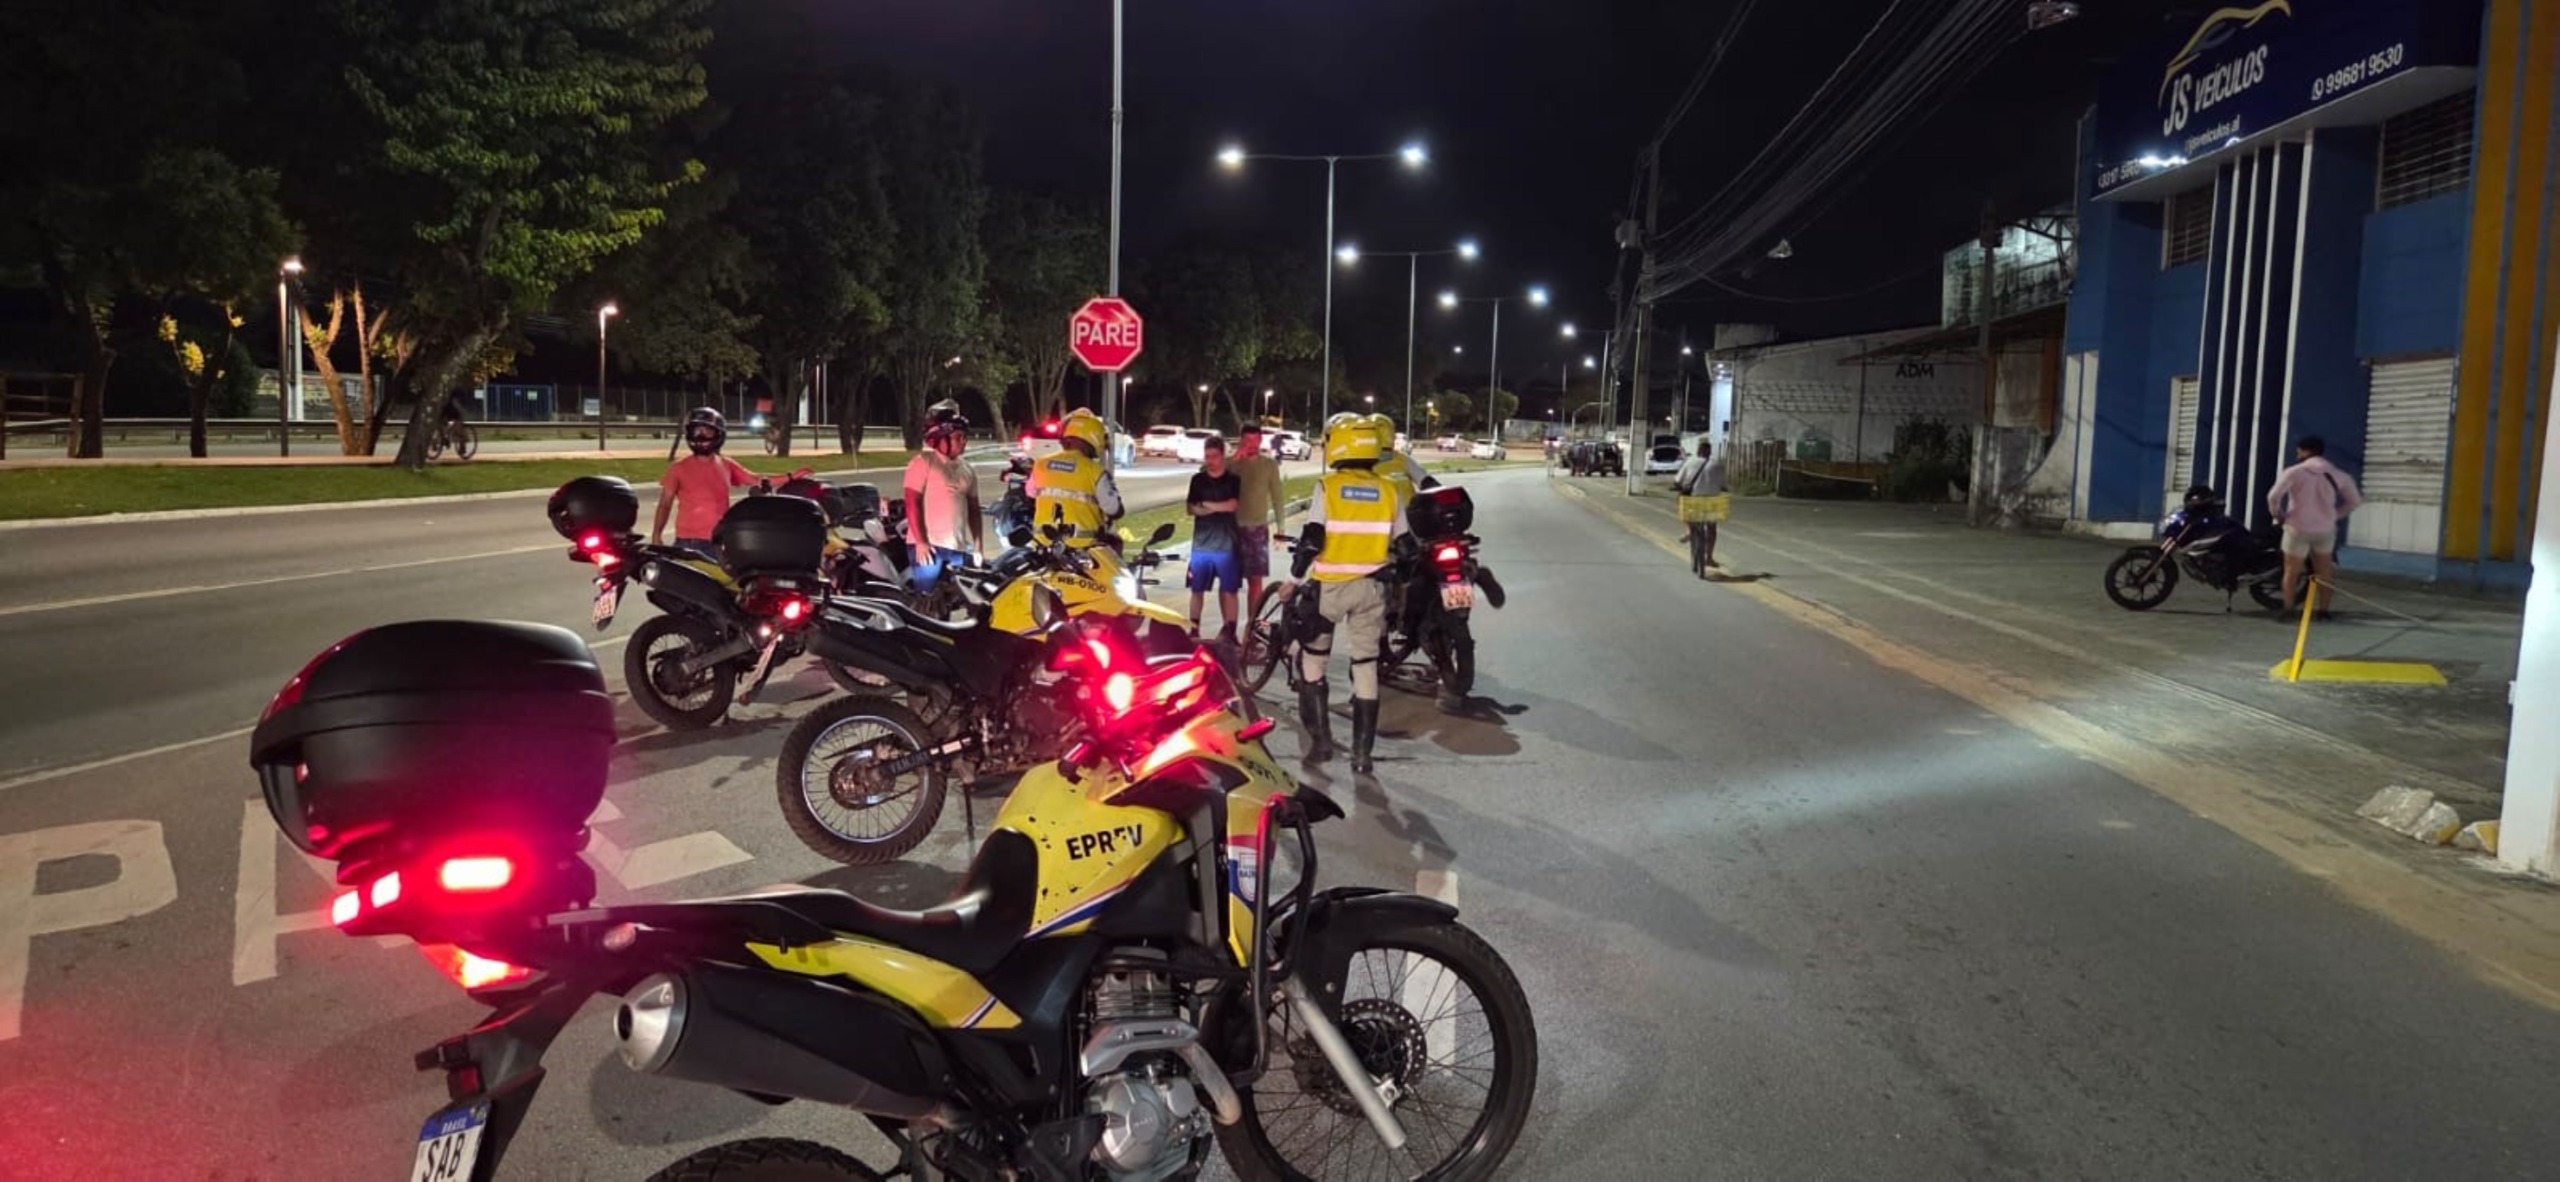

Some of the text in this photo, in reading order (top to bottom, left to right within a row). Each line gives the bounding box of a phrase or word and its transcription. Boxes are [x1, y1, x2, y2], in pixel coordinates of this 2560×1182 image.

[2163, 44, 2268, 137] JS VEÍCULOS
[2325, 43, 2403, 94] 99681 9530
[1075, 321, 1137, 347] PARE
[1895, 362, 1934, 379] ADM
[421, 1133, 466, 1182] SAB
